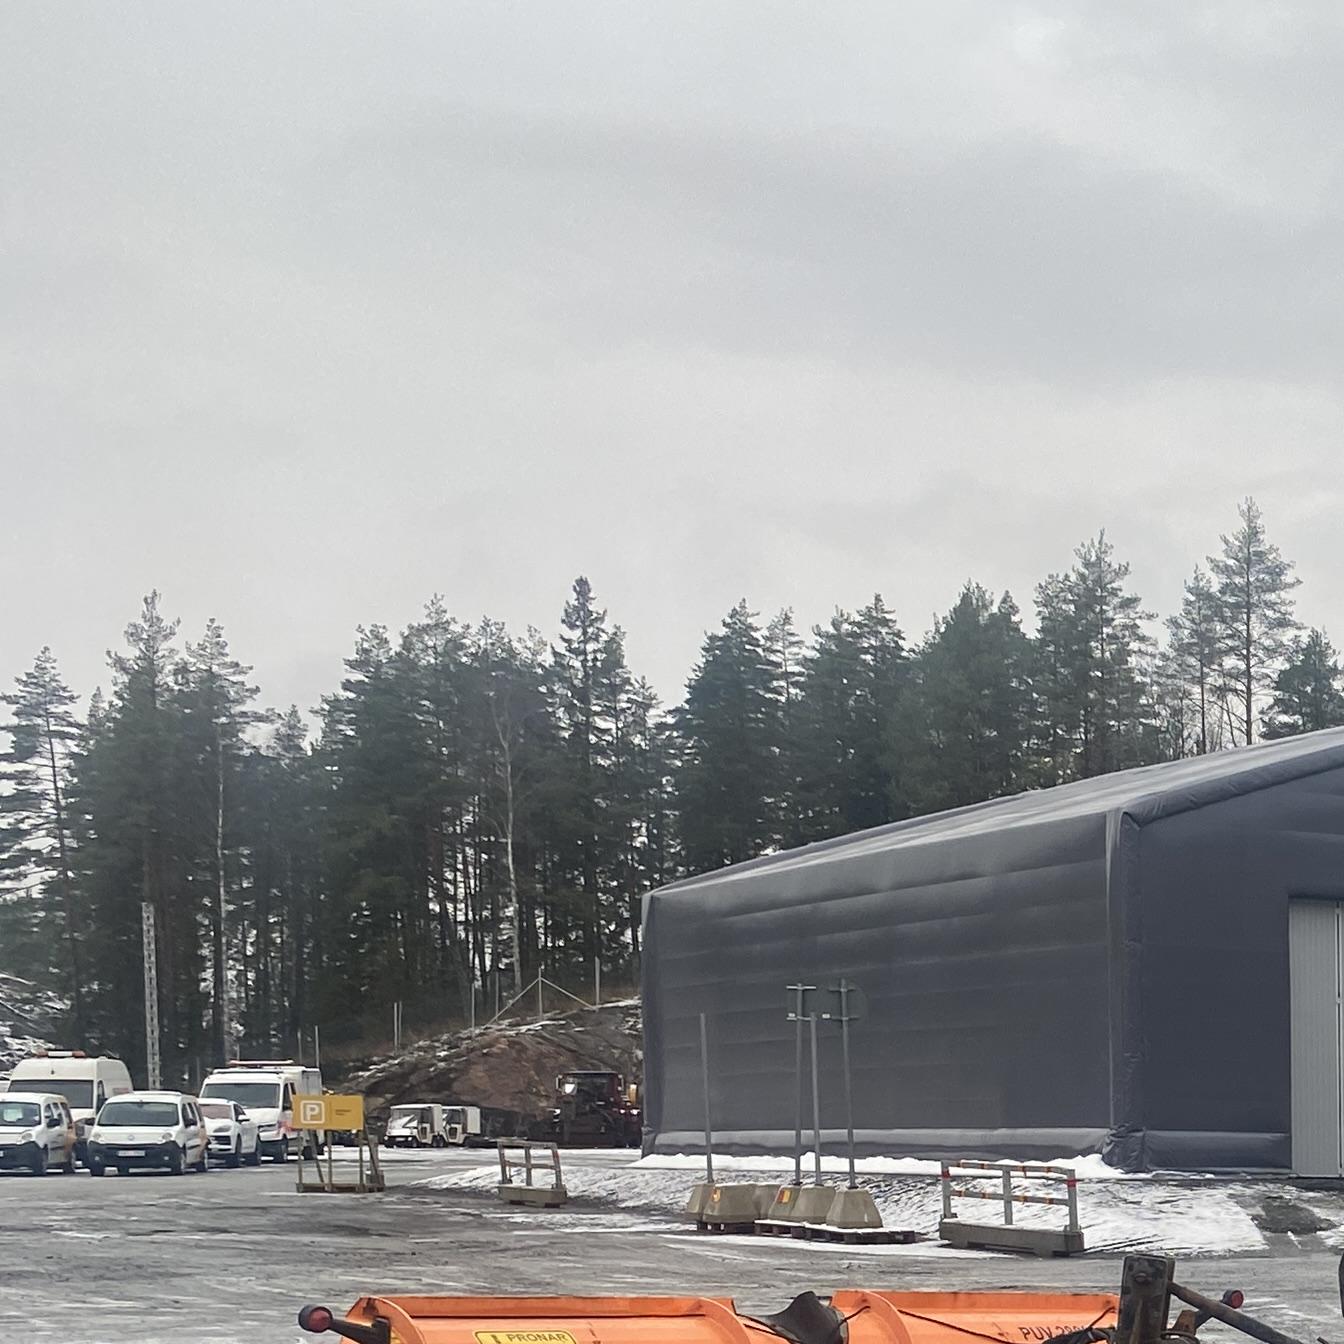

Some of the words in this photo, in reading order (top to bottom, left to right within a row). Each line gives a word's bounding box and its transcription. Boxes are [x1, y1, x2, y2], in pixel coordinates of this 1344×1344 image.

[306, 1104, 319, 1120] P
[505, 1333, 569, 1343] PRONAR
[1018, 1325, 1053, 1341] PUV
